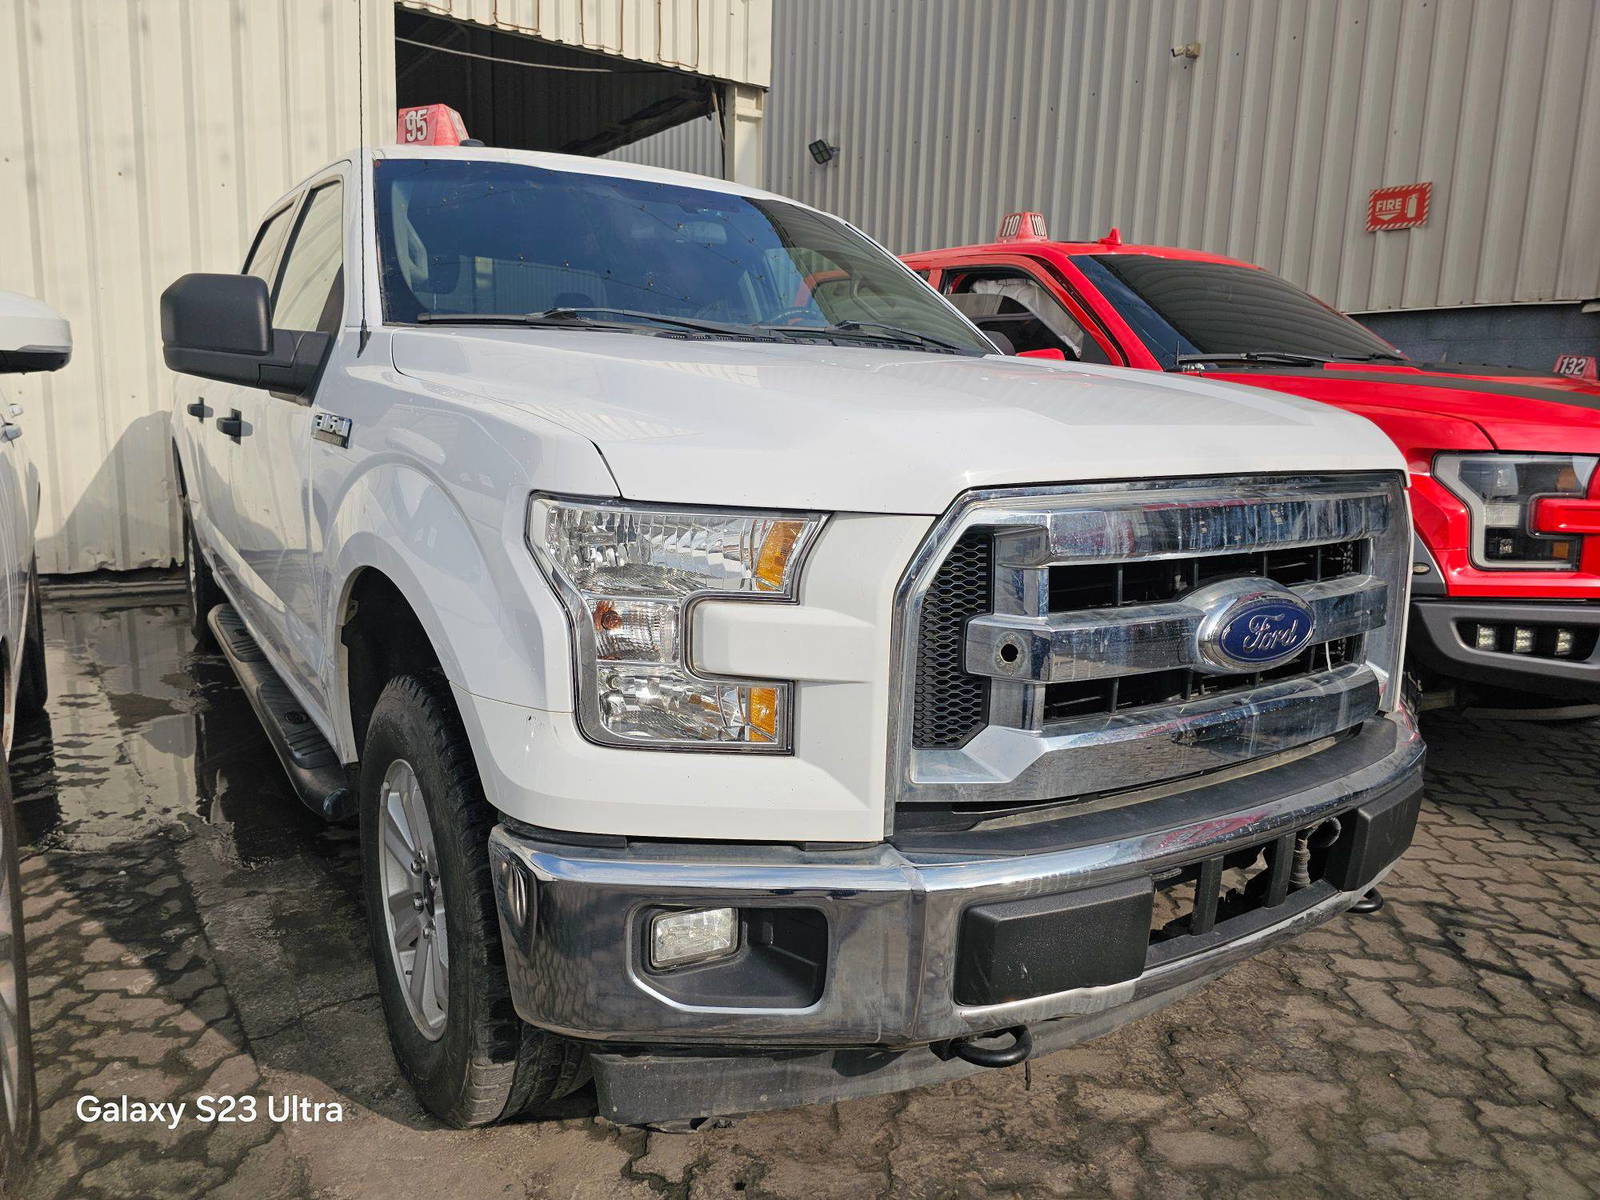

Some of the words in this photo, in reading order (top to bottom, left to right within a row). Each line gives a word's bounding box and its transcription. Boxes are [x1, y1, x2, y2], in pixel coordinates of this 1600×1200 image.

[404, 108, 428, 143] 95
[1375, 198, 1403, 213] FIRE
[1001, 214, 1021, 237] 110
[1560, 357, 1587, 375] 132
[1243, 613, 1299, 653] Ford
